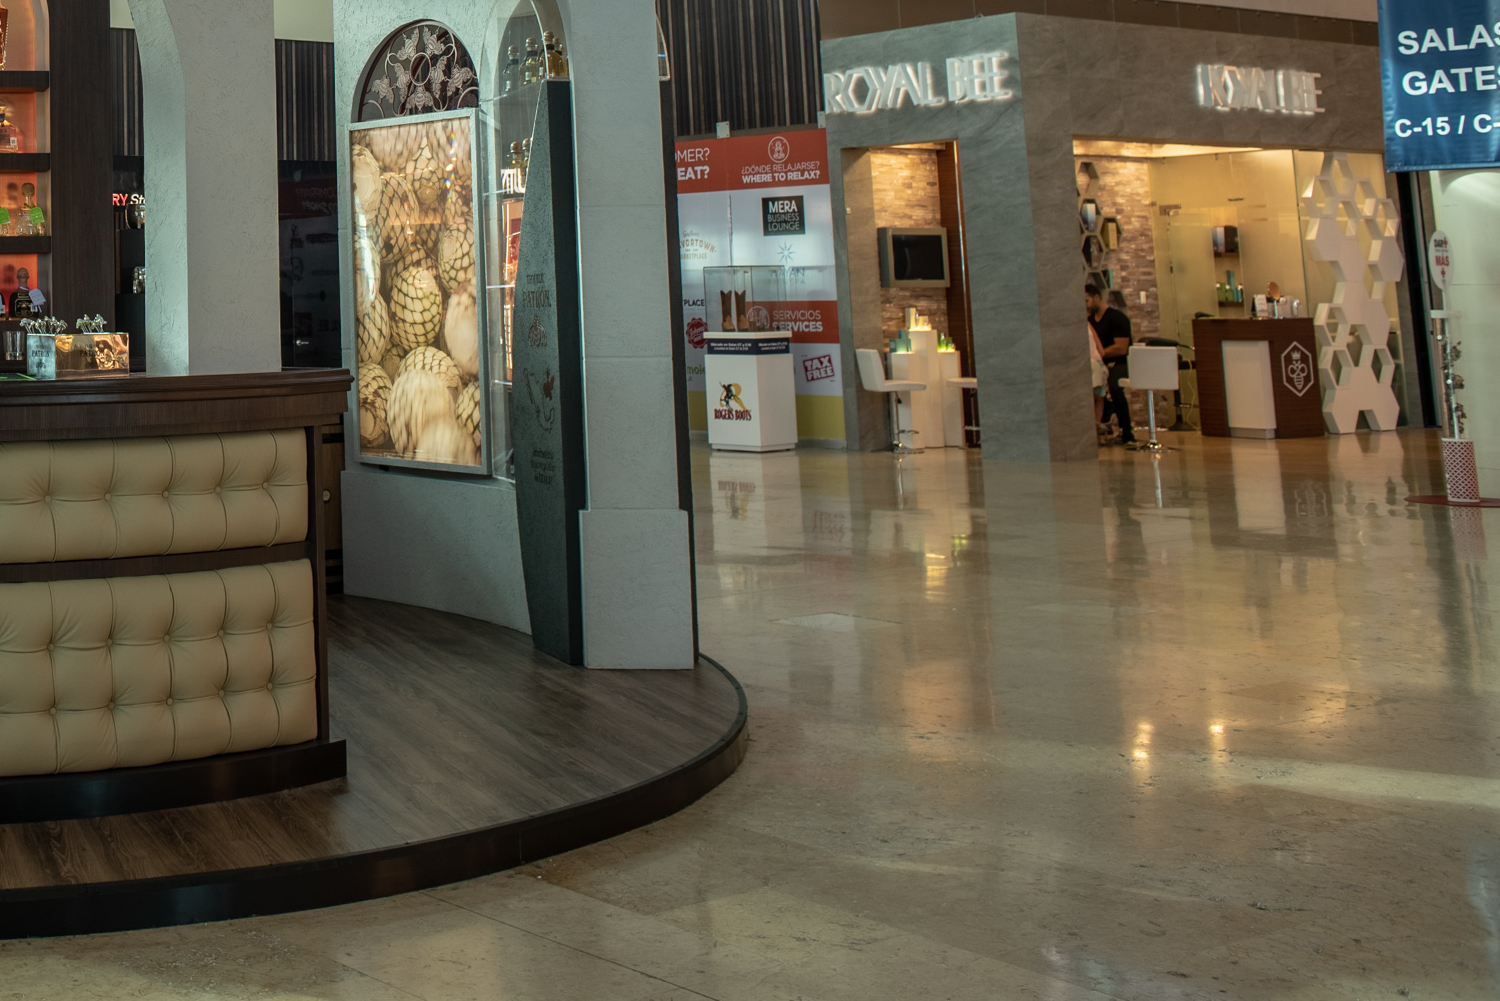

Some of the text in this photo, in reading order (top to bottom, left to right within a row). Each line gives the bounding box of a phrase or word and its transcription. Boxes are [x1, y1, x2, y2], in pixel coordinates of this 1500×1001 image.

[823, 51, 1014, 115] ROYAL BEE
[1402, 65, 1500, 96] GATE
[1394, 116, 1451, 138] C-15
[1457, 115, 1466, 135] /
[675, 148, 710, 163] MER?
[677, 166, 710, 181] EAT?
[741, 161, 820, 175] ¿DÓNDE RELAJARSE?
[742, 170, 820, 184] WHERE TO RELAX?
[130, 193, 146, 205] St
[768, 200, 798, 214] MERA
[767, 213, 799, 223] BUSINESS
[768, 221, 800, 231] LOUNGE
[773, 309, 822, 321] SERVICIOS
[772, 321, 823, 332] SERVICES
[805, 356, 831, 371] TAX
[806, 366, 834, 381] FREE
[713, 408, 752, 421] ROGERS BOOTS
